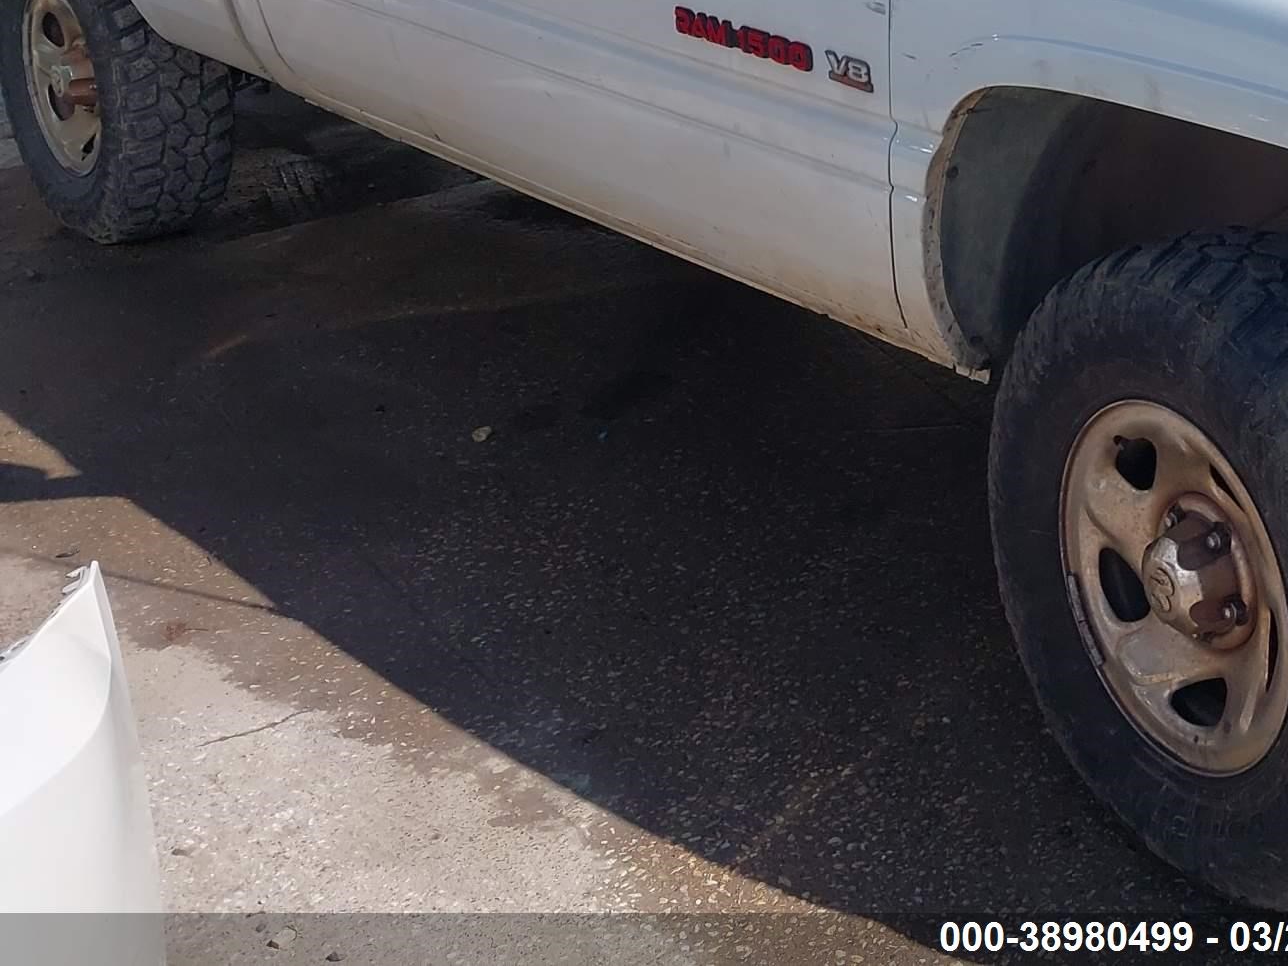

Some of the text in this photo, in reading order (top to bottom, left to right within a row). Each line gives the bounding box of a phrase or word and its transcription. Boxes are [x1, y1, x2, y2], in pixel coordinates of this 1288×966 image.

[675, 6, 733, 48] RAM
[736, 25, 814, 72] 1500
[825, 50, 872, 85] V8
